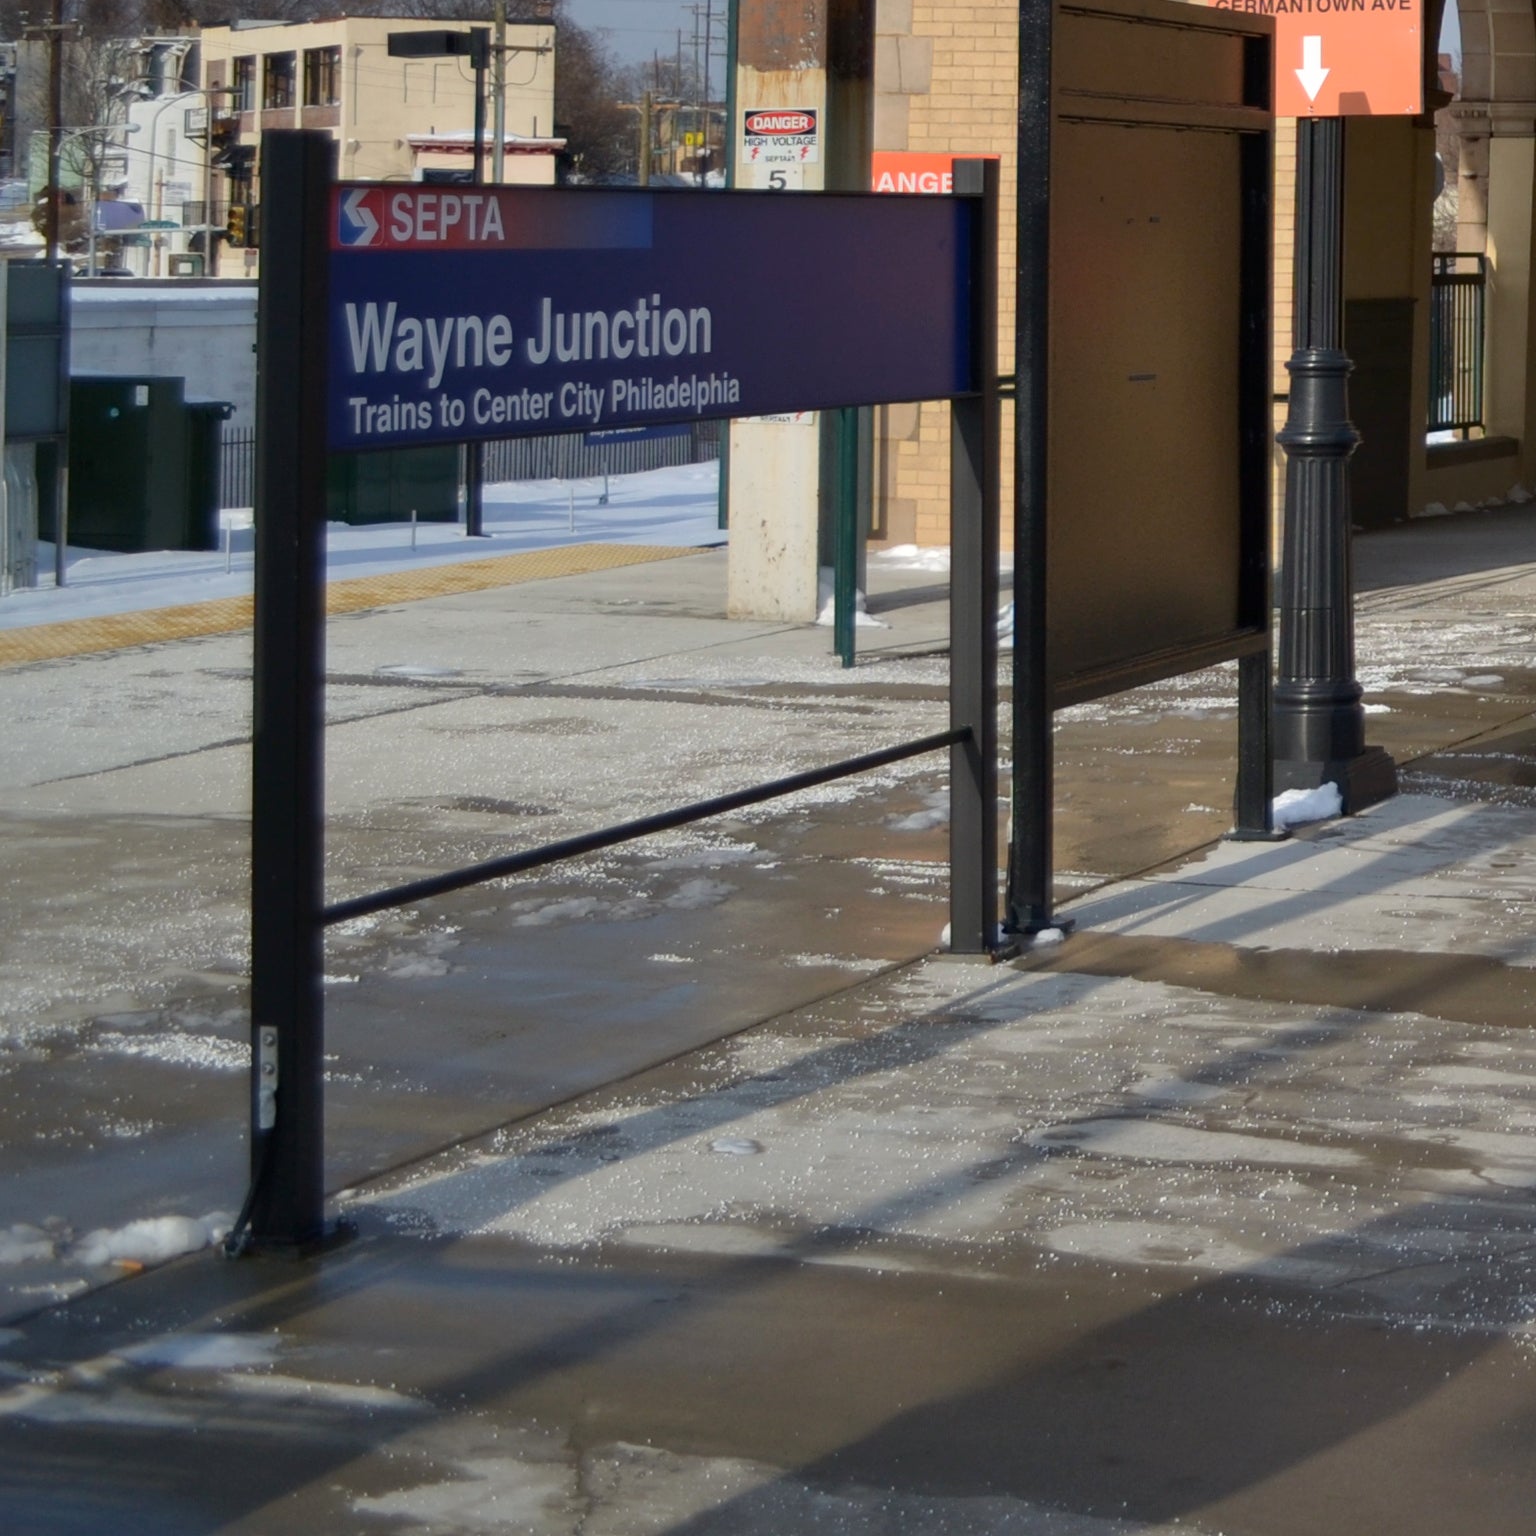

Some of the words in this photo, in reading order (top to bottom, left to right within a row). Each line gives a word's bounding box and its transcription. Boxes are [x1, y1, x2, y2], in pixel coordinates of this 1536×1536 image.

[753, 116, 809, 130] DANGER
[744, 137, 768, 146] HIGH
[772, 136, 817, 146] VOLTAGE
[768, 170, 787, 190] 5
[872, 171, 953, 193] ANGE
[391, 192, 505, 242] SEPTA
[345, 300, 514, 389] Wayne
[527, 293, 712, 364] Junction
[349, 395, 433, 434] Trains
[440, 393, 465, 428] to
[473, 387, 554, 426] Center
[560, 380, 605, 424] City
[611, 372, 740, 414] Philadelphia
